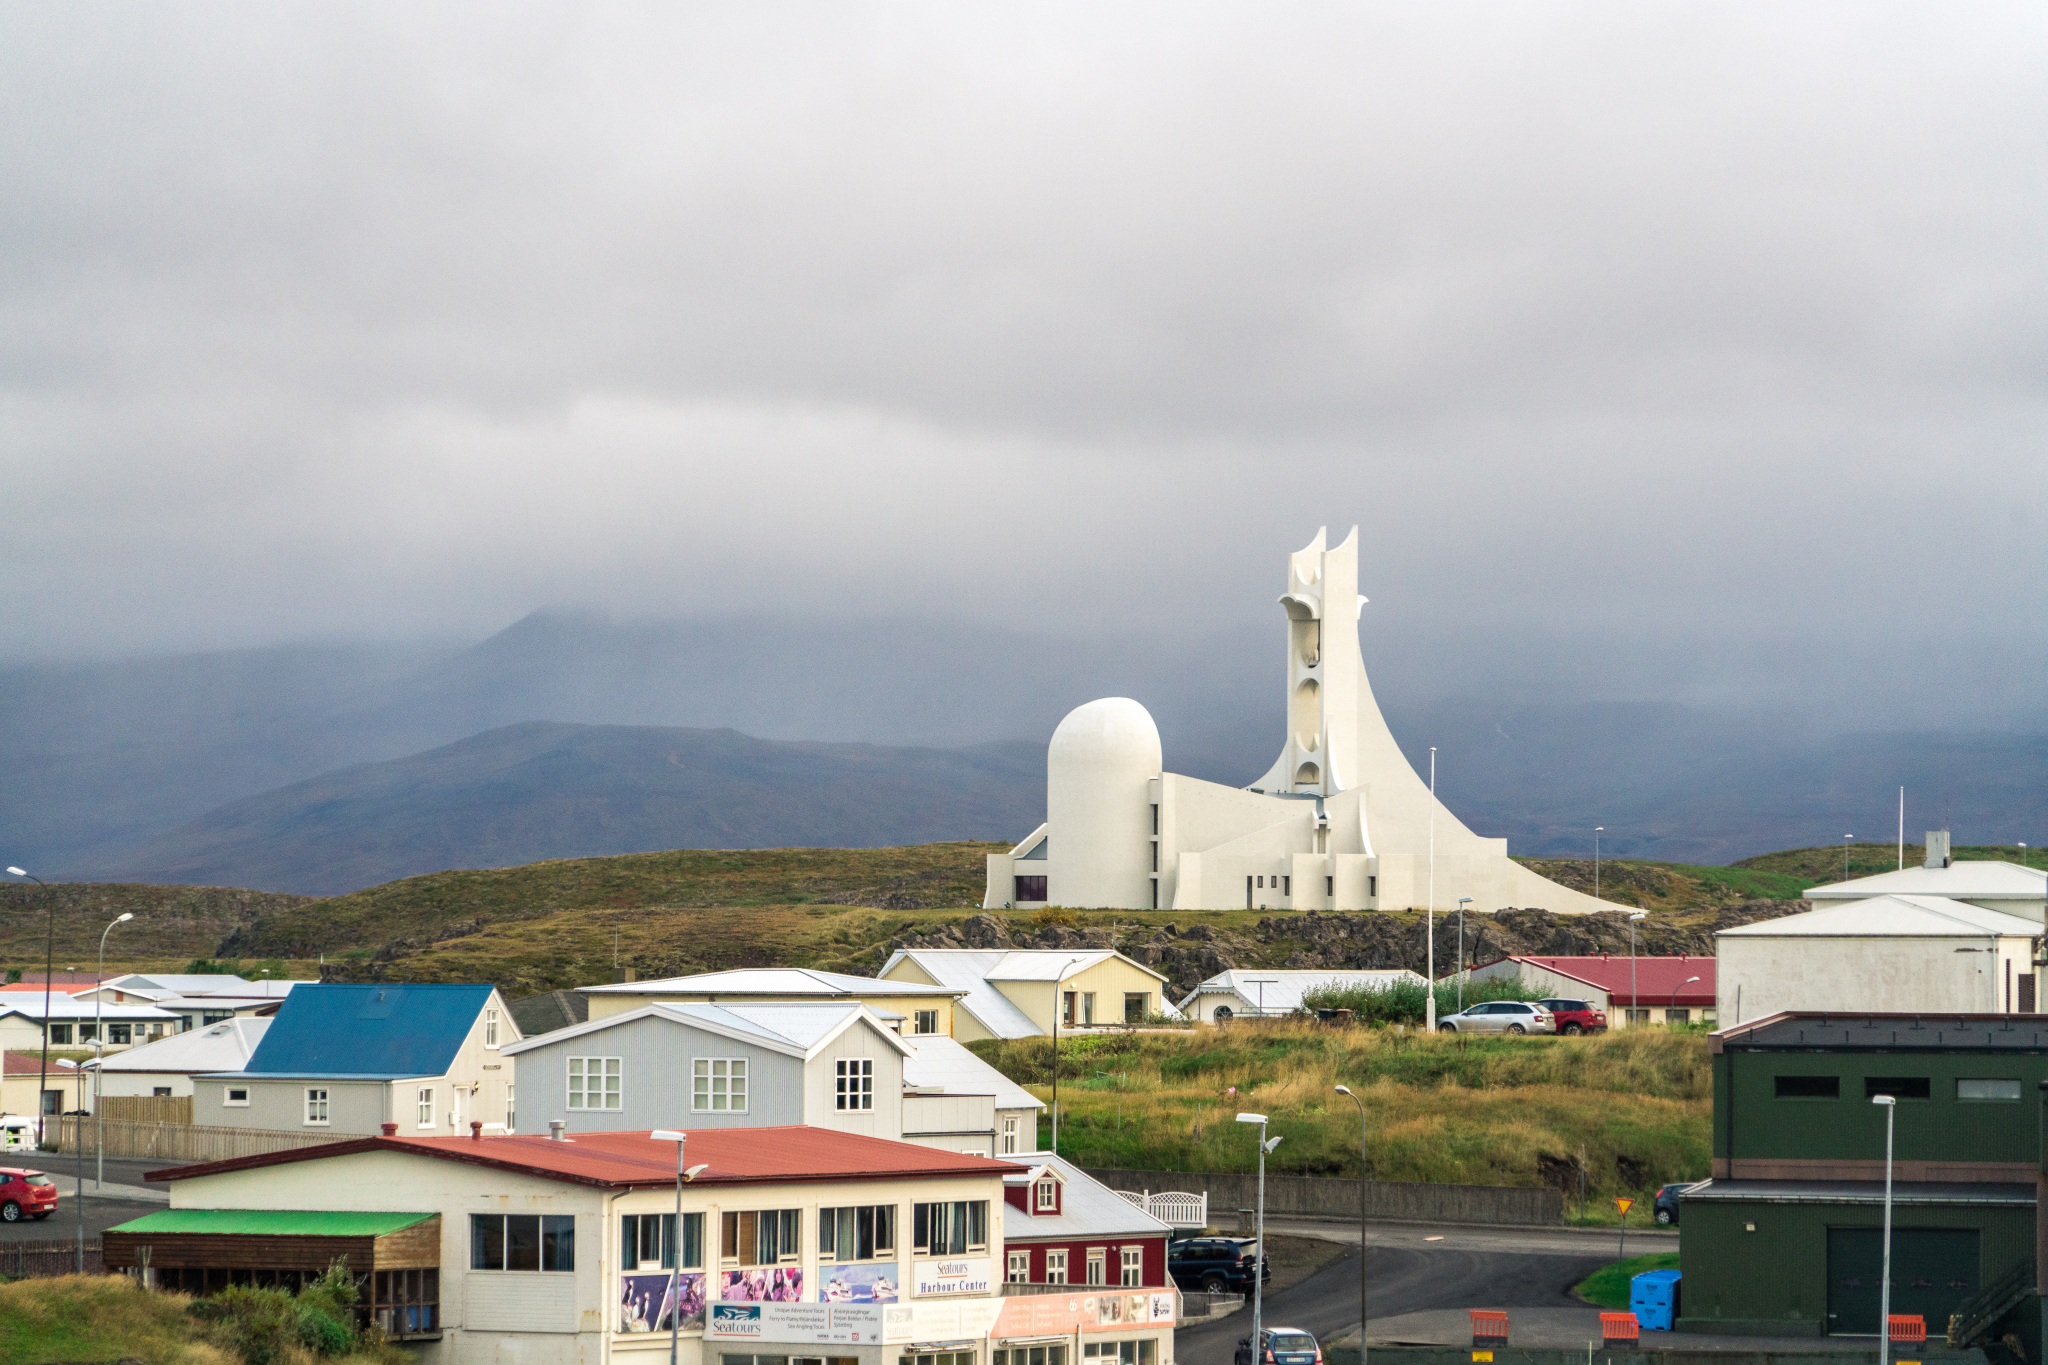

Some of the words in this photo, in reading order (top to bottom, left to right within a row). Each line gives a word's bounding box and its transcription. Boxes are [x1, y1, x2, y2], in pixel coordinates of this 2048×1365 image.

[937, 1262, 968, 1275] Seatours
[920, 1282, 956, 1294] Harbour
[959, 1280, 987, 1291] Center
[713, 1320, 761, 1334] Seatours
